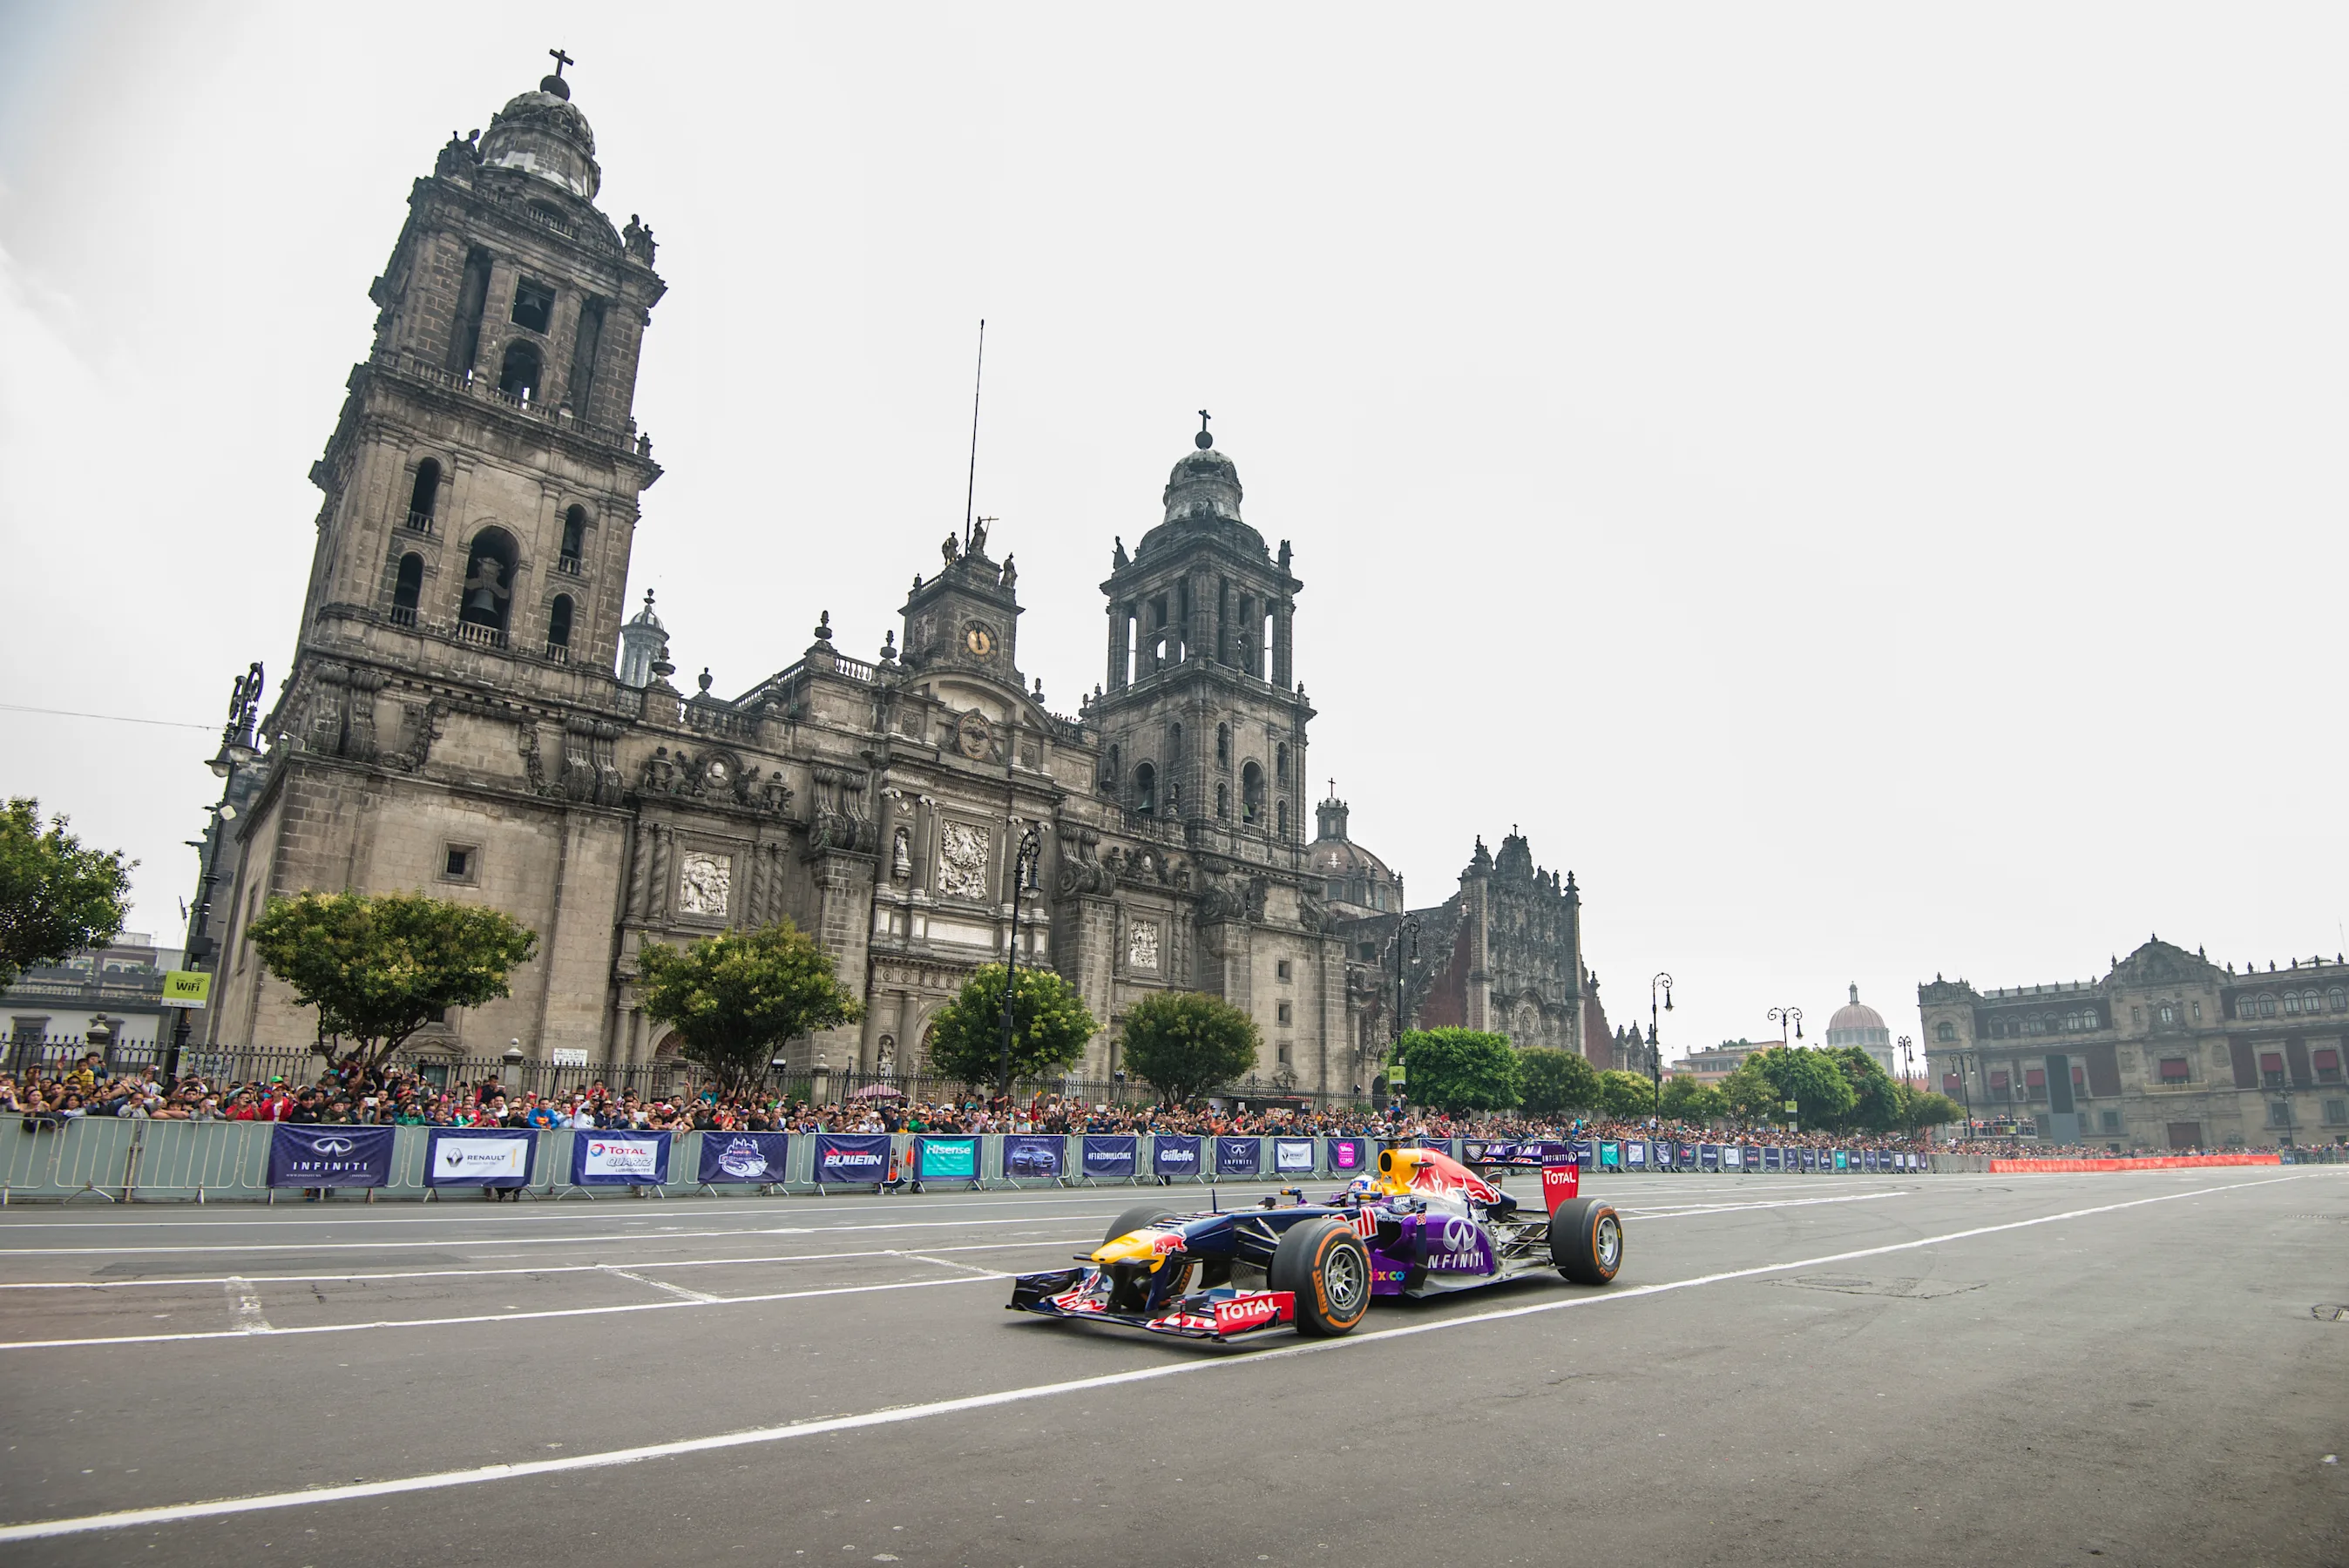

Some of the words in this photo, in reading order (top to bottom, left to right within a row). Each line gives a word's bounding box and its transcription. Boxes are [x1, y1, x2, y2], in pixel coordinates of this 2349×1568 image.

[176, 982, 200, 991] WiFi
[926, 1145, 971, 1154] Hisense
[823, 1155, 883, 1165] BULLETIN
[1161, 1149, 1195, 1161] Gillette
[293, 1161, 368, 1171] INFINITI
[606, 1157, 653, 1166] QUARTZ
[1544, 1171, 1576, 1185] TOTAL
[1428, 1252, 1484, 1268] NFINITI
[1217, 1297, 1282, 1321] TOTAL
